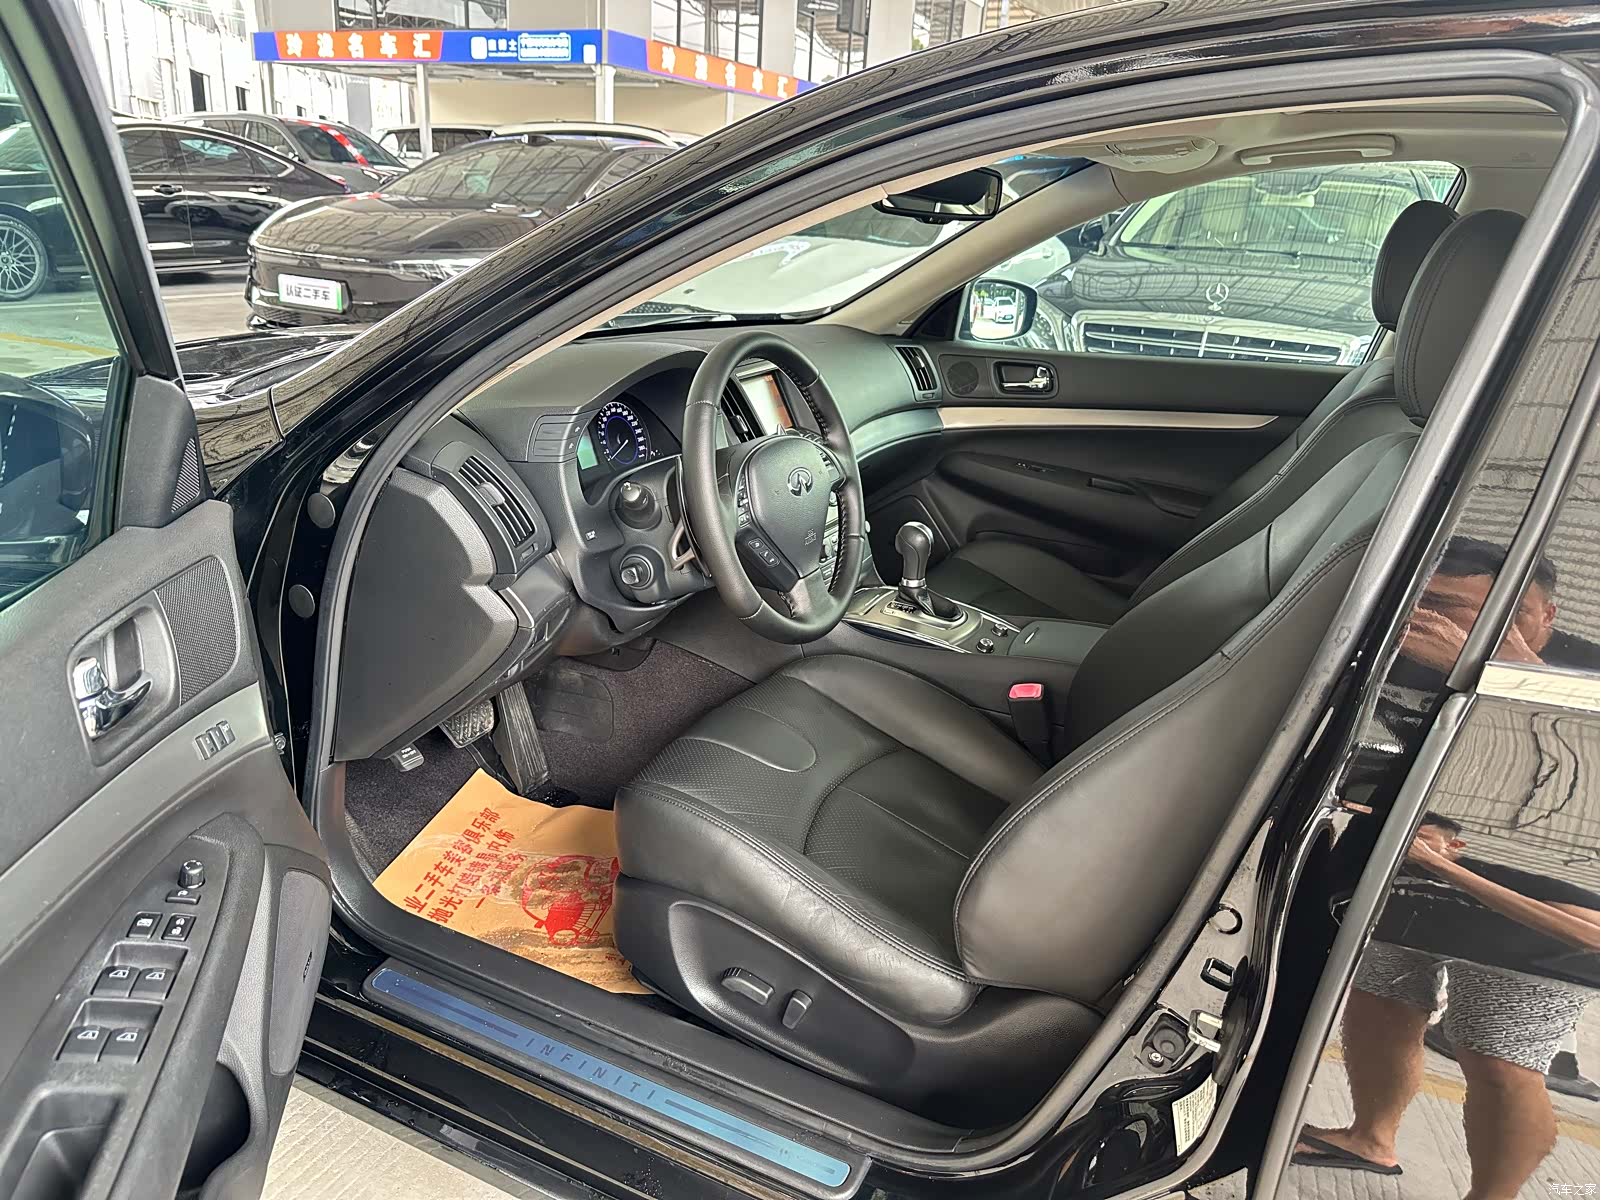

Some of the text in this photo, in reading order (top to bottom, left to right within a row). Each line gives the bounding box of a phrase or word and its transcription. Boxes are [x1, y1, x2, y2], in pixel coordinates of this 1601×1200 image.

[286, 284, 331, 302] 认证二手车
[403, 807, 501, 913] 业二手车美容俱乐部
[526, 1038, 656, 1100] INFINITI
